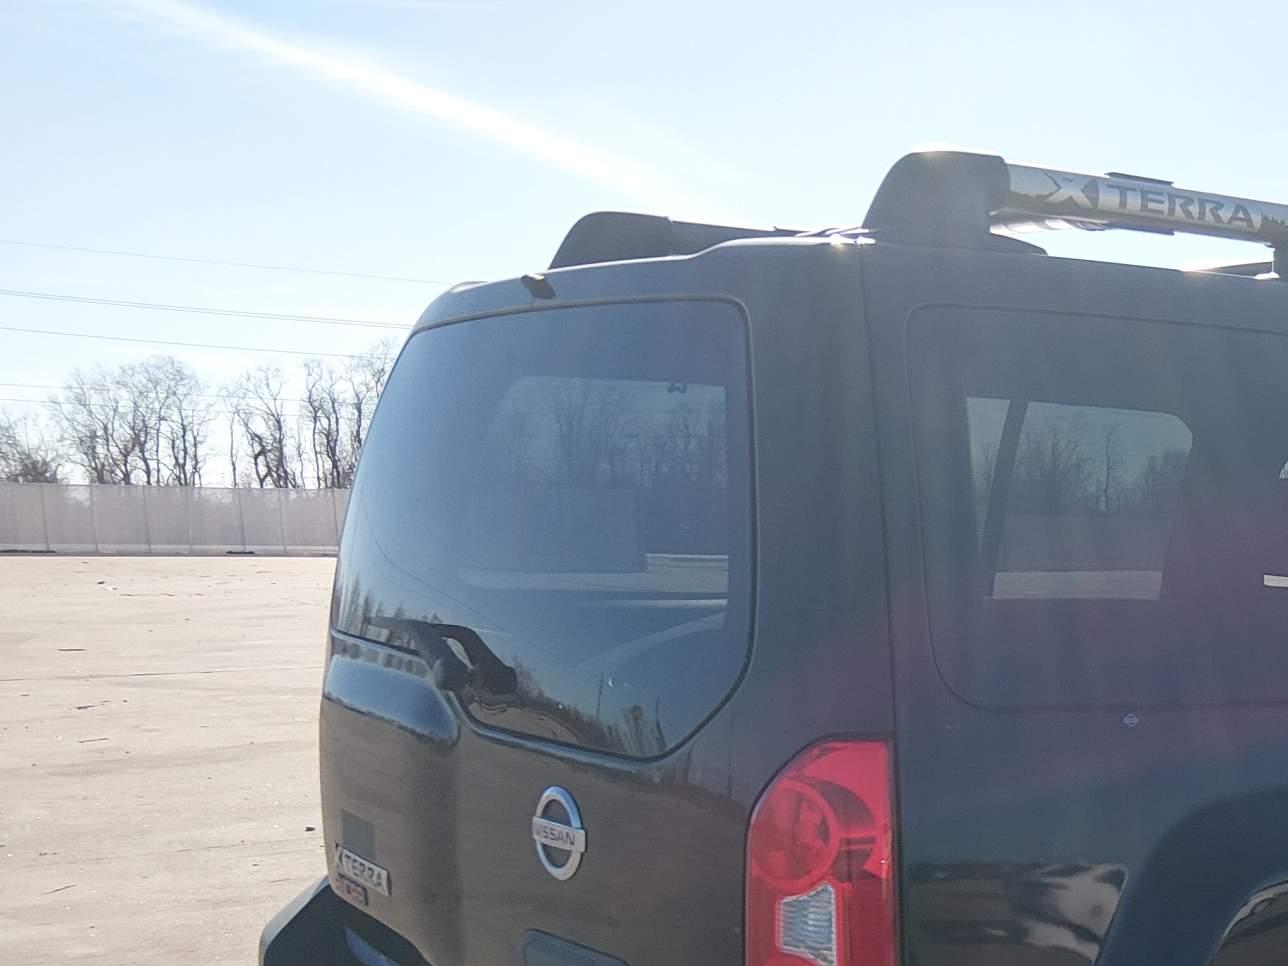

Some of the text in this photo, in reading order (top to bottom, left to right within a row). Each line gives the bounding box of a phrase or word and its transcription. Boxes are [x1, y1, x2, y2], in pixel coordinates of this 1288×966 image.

[1046, 170, 1257, 231] XTERRA
[534, 821, 577, 846] NISSAN
[334, 843, 388, 896] XTERRA
